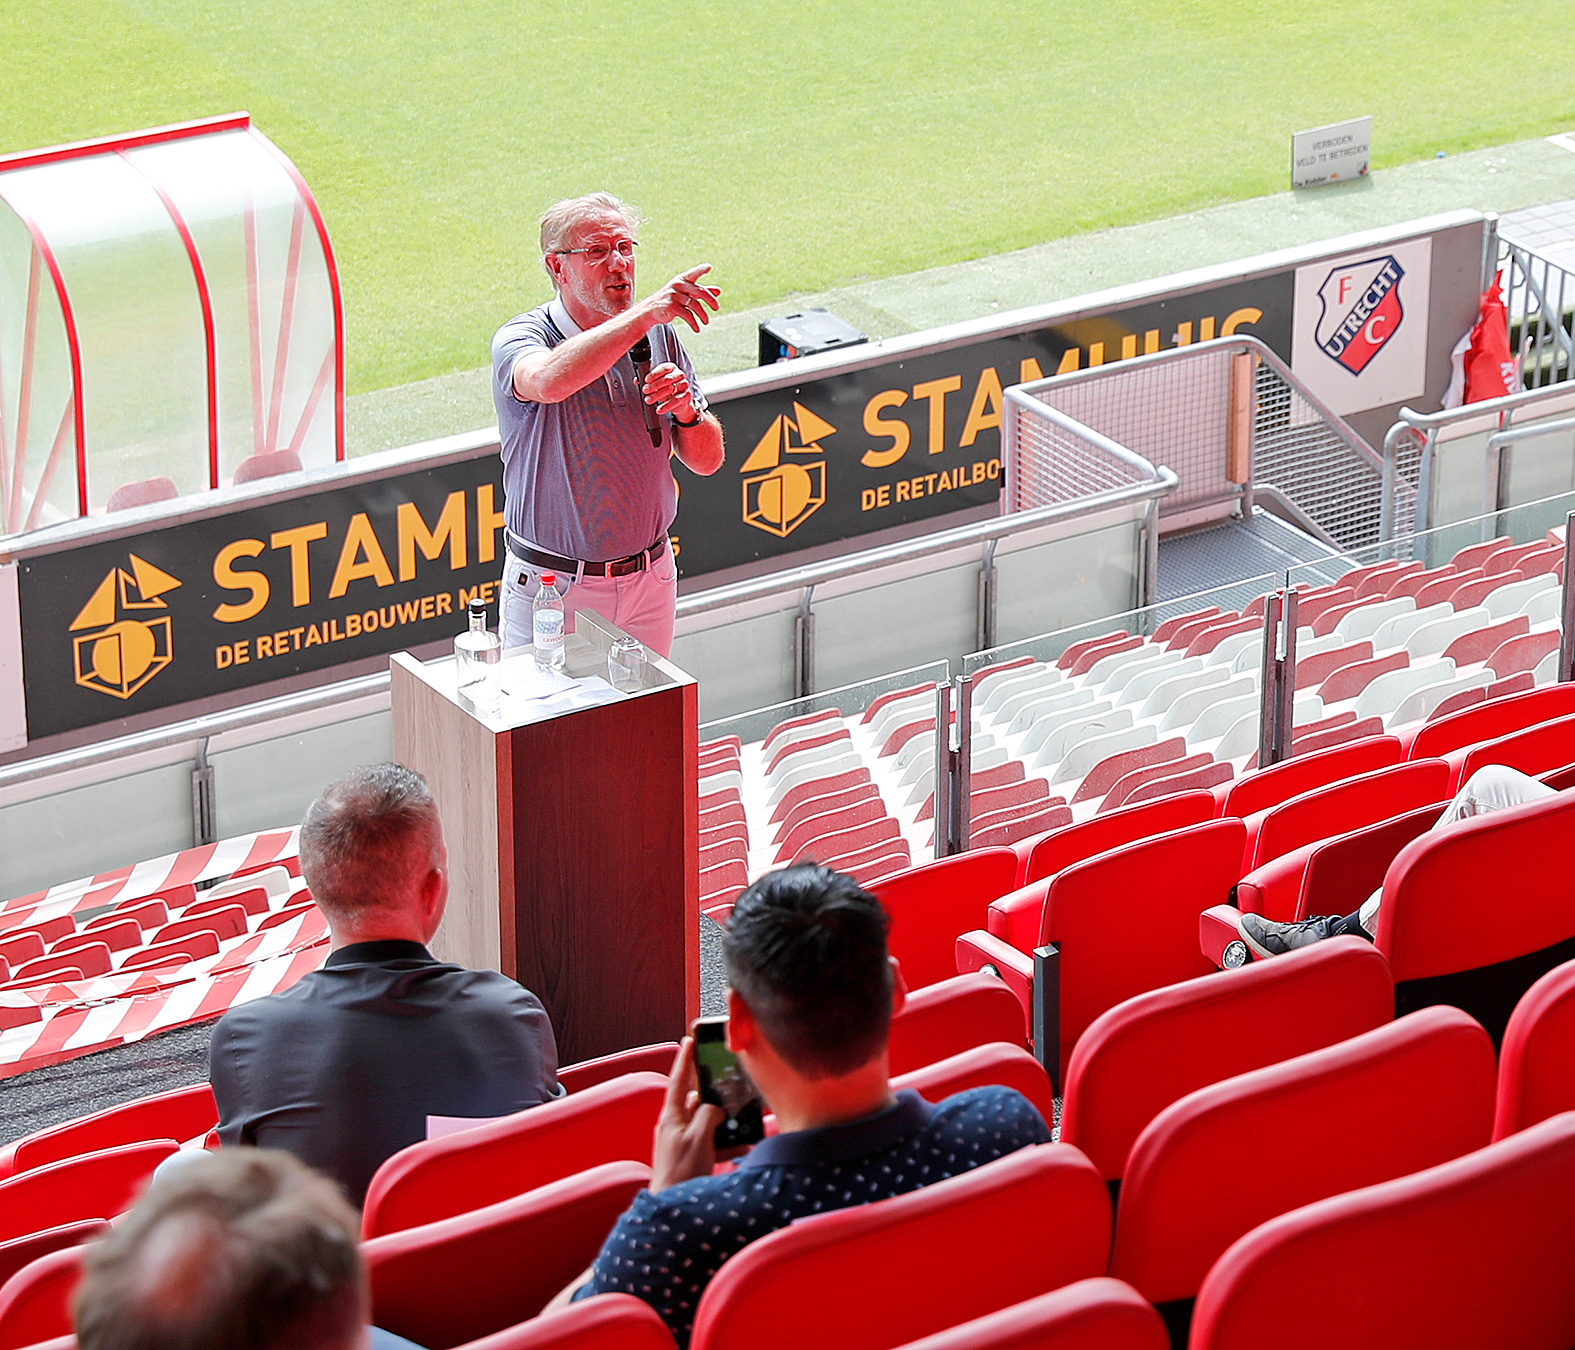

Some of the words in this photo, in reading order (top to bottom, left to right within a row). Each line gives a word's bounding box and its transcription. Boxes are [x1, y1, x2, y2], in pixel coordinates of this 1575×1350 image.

[1324, 261, 1399, 359] UTRECHT
[1339, 275, 1353, 305] F
[1364, 314, 1386, 345] C
[861, 484, 891, 512] DE
[895, 458, 1000, 503] RETAILBO
[215, 640, 250, 670] DE
[256, 592, 453, 660] RETAILBOUWER
